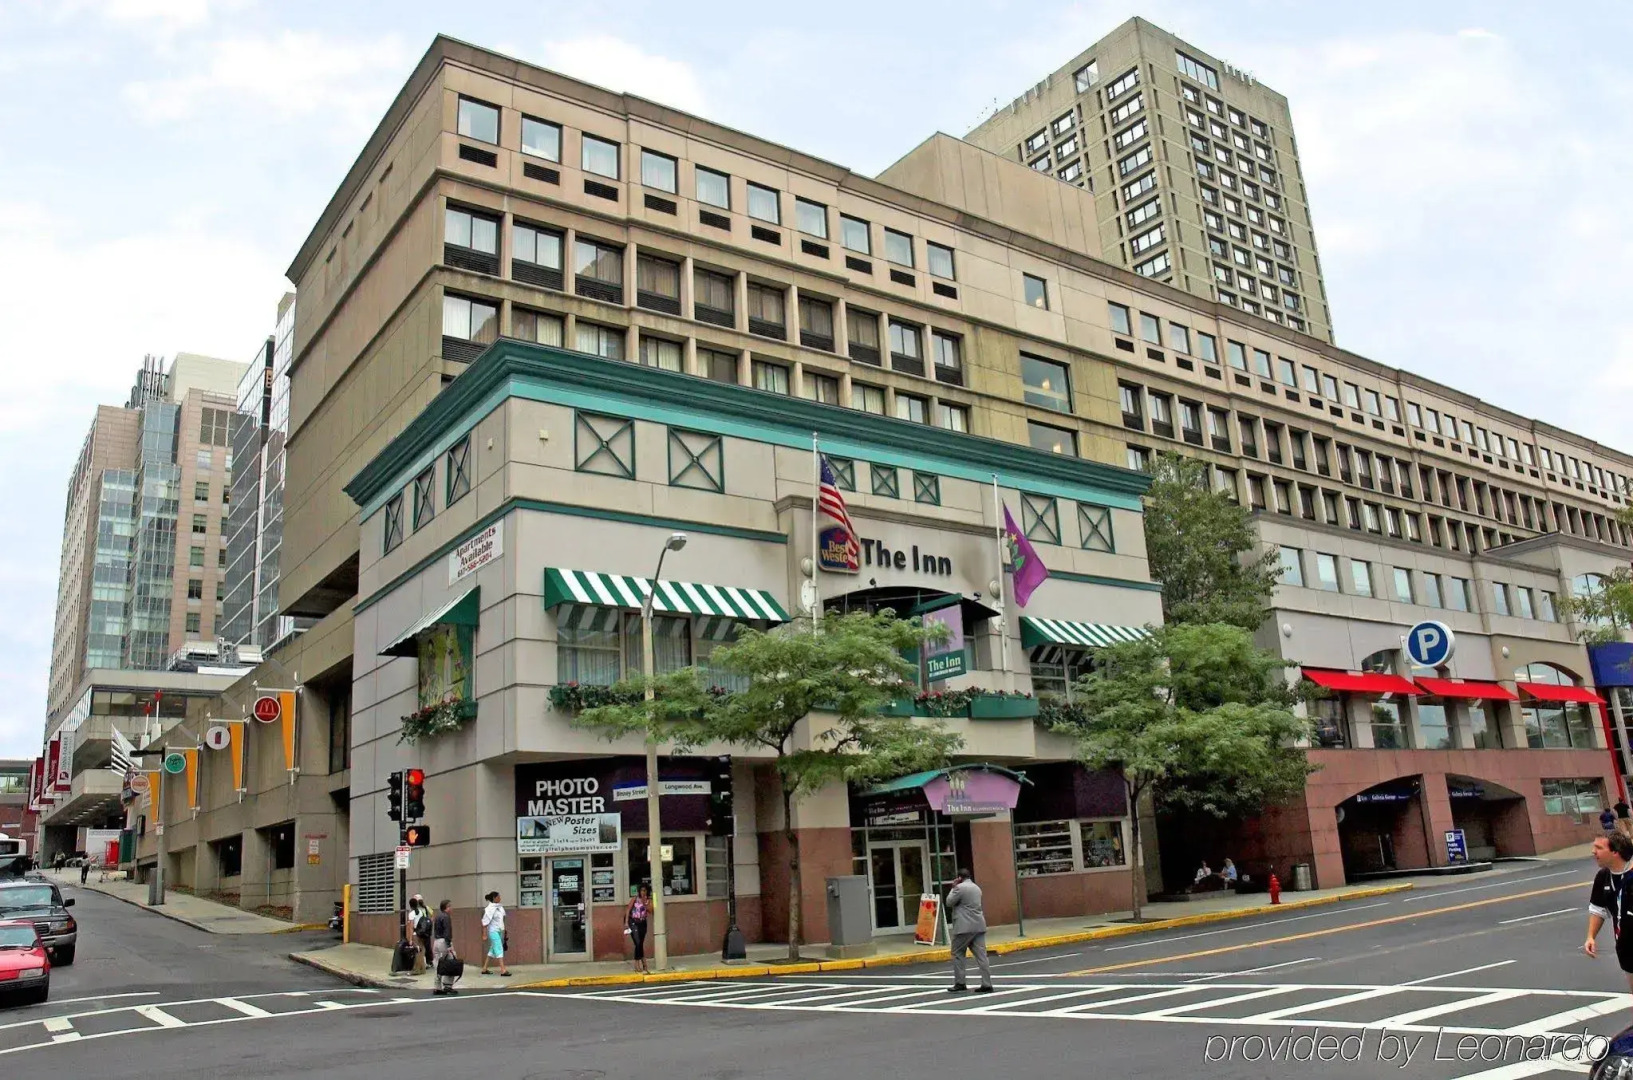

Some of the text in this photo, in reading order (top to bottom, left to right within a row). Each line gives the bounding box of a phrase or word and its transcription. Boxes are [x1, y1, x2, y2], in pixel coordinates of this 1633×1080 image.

[456, 527, 496, 558] Apartments
[460, 541, 493, 566] Available
[821, 548, 849, 563] Weste
[860, 538, 952, 576] The Inn
[1416, 627, 1440, 661] P
[927, 656, 961, 673] The Inn
[535, 777, 599, 797] PHOTO
[527, 796, 605, 816] MASTER
[947, 804, 959, 813] The
[960, 803, 972, 812] Inn
[545, 816, 596, 828] NEW Poster
[572, 826, 597, 835] Sizes
